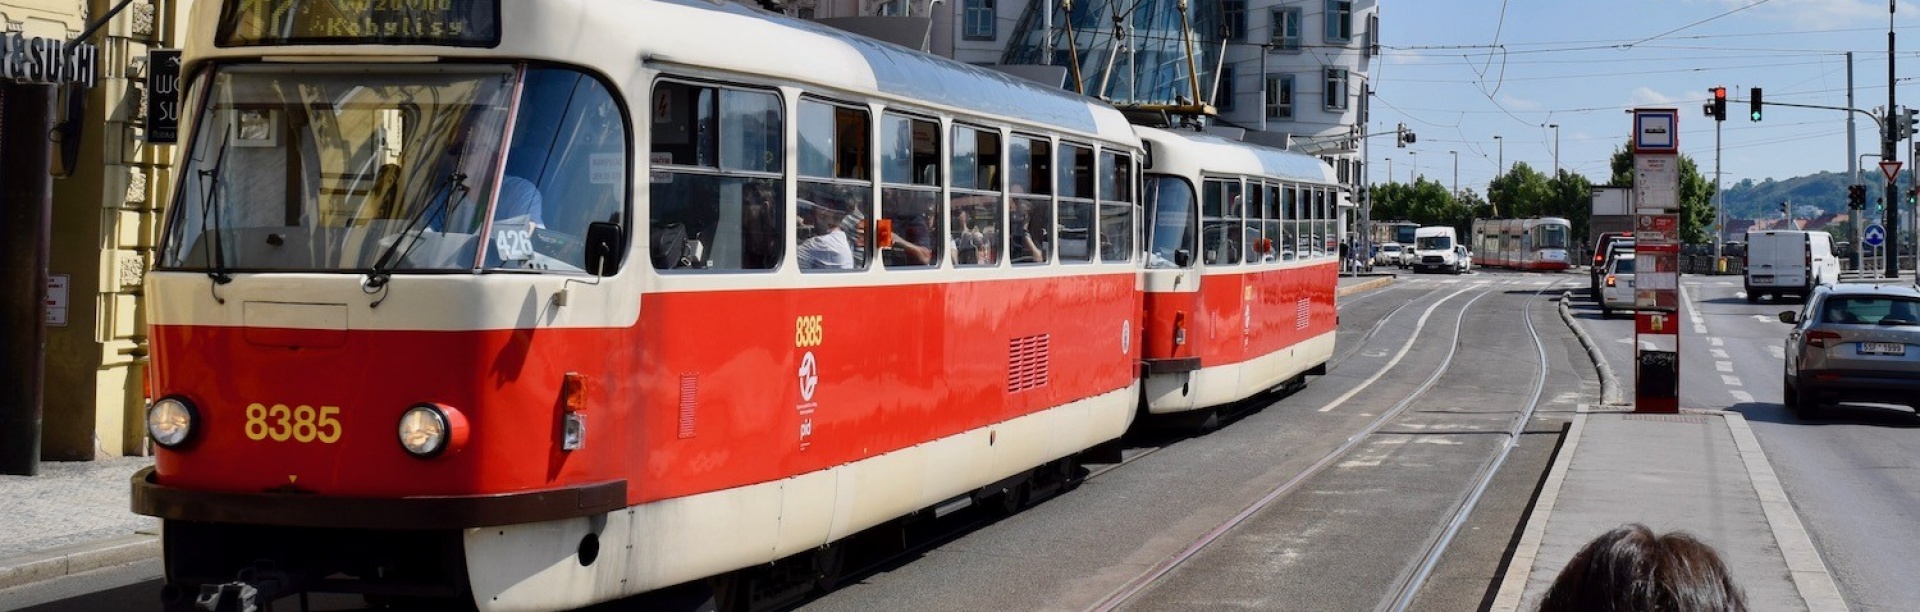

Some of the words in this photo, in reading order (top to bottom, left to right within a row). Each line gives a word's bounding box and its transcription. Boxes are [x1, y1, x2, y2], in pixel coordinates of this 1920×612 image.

[327, 17, 463, 36] Kobylisy
[497, 229, 532, 254] 426
[795, 314, 823, 348] 8385
[245, 402, 342, 443] 8385
